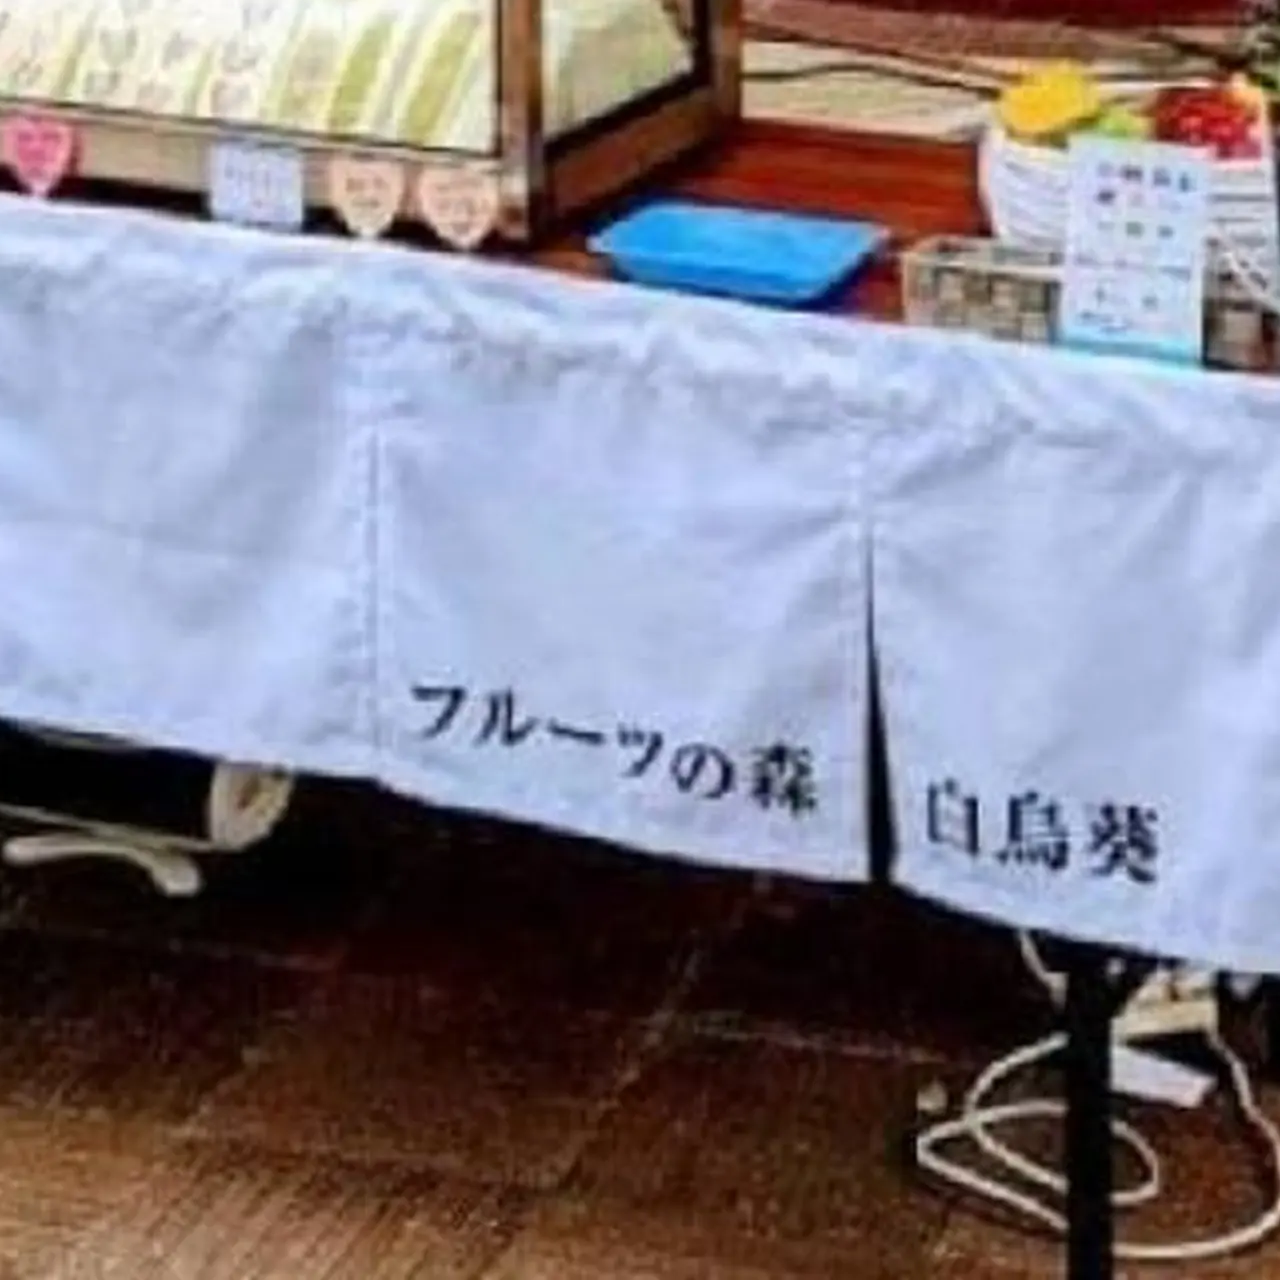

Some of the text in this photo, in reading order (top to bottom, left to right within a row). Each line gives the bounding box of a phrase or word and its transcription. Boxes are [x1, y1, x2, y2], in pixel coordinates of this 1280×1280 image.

[410, 684, 819, 818] フルーツの森
